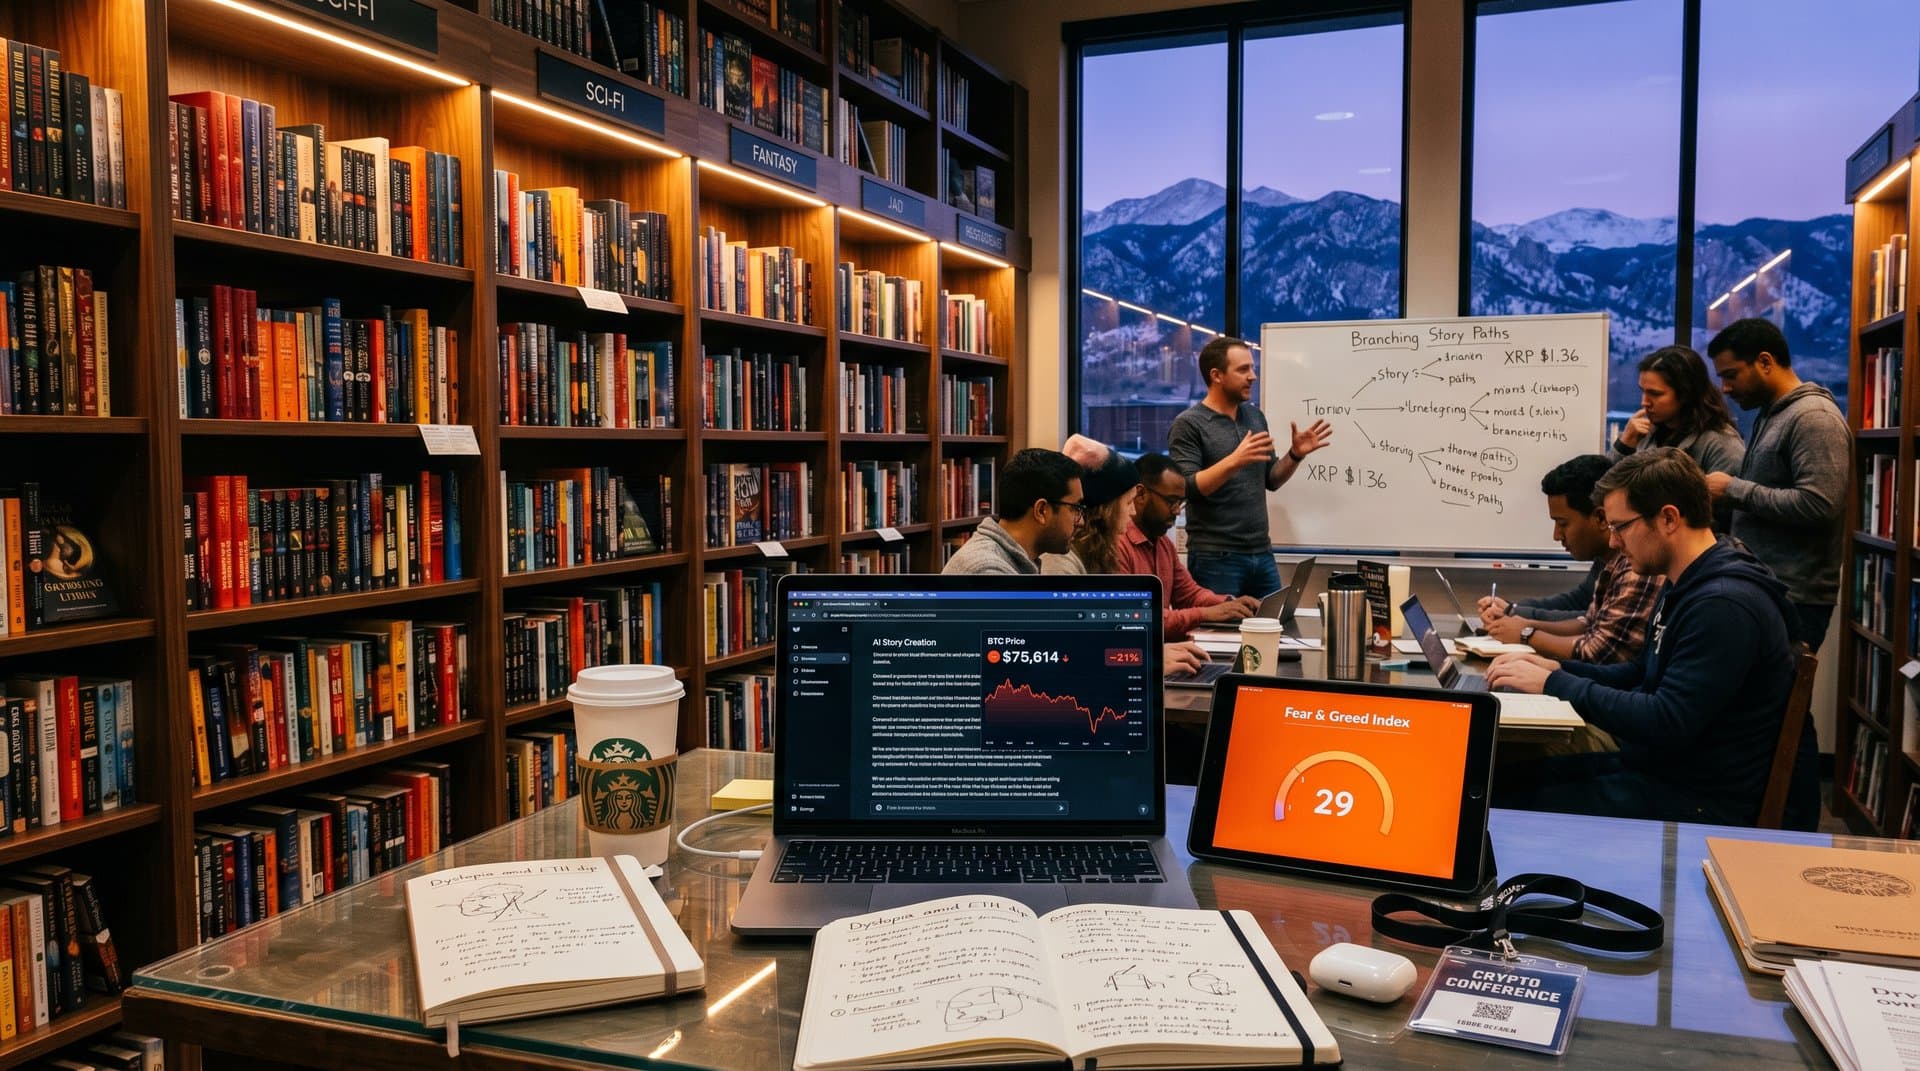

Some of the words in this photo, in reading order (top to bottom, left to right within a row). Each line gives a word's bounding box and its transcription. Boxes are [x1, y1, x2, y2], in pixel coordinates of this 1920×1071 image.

[585, 81, 625, 112] SCI-FI
[752, 144, 798, 175] FANTASY
[1351, 331, 1419, 350] Branching
[1429, 328, 1464, 345] Story
[1472, 326, 1510, 341] Paths
[1503, 350, 1534, 365] XRP
[1540, 349, 1579, 364] $1.36
[1377, 367, 1409, 385] Story
[1307, 464, 1338, 481] XRP
[872, 638, 882, 647] AI
[882, 638, 903, 649] Story
[904, 638, 937, 647] Creation
[987, 637, 1004, 645] BTC
[1005, 637, 1026, 645] Price
[1002, 651, 1059, 664] $75,614
[1284, 706, 1312, 720] Fear
[1315, 709, 1326, 721] &
[1329, 710, 1369, 725] Greed
[1372, 714, 1410, 729] Index
[1313, 788, 1354, 817] 29
[430, 867, 494, 887] Dystopia
[849, 912, 914, 931] Dystopia
[923, 903, 960, 916] amid
[1472, 970, 1541, 988] CRYPTO
[1445, 977, 1561, 1003] CONFERENCE
